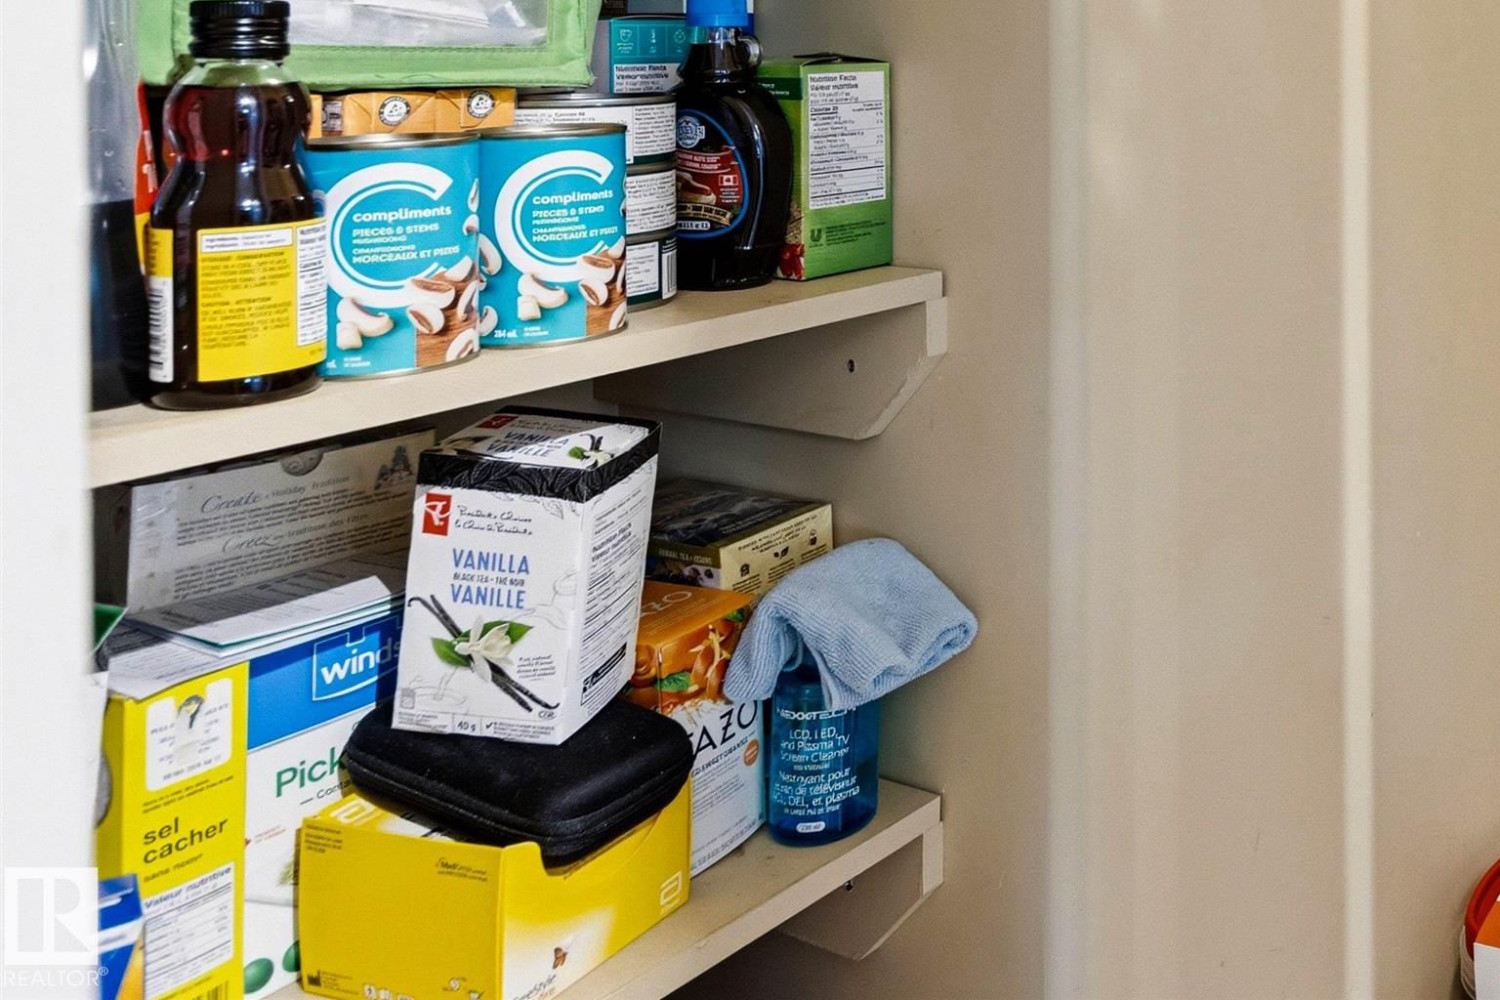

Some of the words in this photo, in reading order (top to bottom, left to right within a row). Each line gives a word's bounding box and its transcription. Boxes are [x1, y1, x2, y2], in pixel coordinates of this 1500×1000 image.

[532, 188, 613, 206] compliments
[352, 205, 452, 223] compliments
[503, 431, 570, 446] VANILLA
[486, 442, 551, 457] VANILLE
[452, 548, 530, 575] VANILLA
[453, 572, 476, 583] BLACK
[450, 584, 526, 609] VANILLE
[457, 720, 469, 732] 40
[797, 741, 834, 752] Plasma
[836, 734, 850, 745] TV
[811, 746, 850, 762] Cleaner
[827, 767, 851, 782] pour
[825, 785, 861, 806] plasma
[143, 816, 179, 846] sel
[143, 818, 229, 865] cacher
[144, 887, 183, 910] Valeur
[186, 866, 231, 893] nutritive
